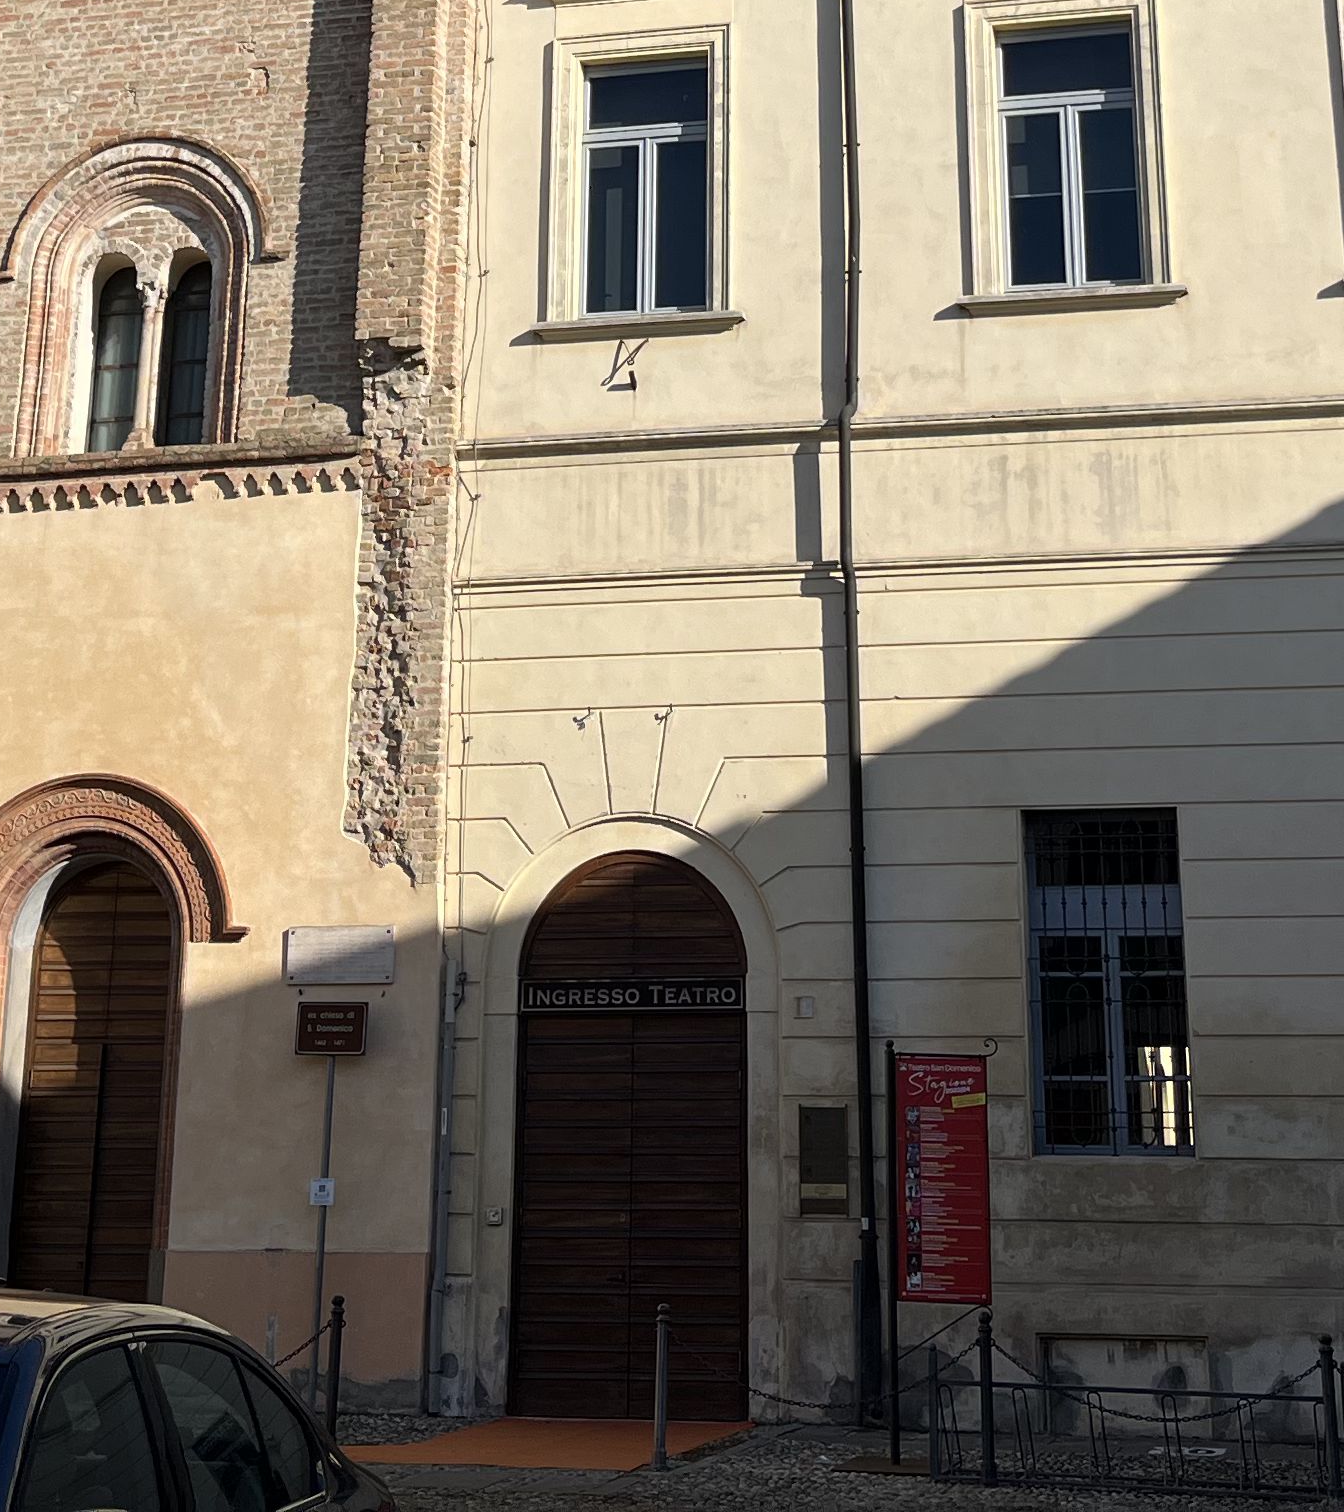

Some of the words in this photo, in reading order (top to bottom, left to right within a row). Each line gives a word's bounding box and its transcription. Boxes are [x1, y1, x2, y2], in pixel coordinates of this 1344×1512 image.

[527, 986, 640, 1006] INGRESSO
[648, 985, 737, 1005] TEATRO
[908, 1063, 931, 1072] Teatro
[944, 1064, 982, 1073] Domenico
[906, 1071, 976, 1104] Stagione
